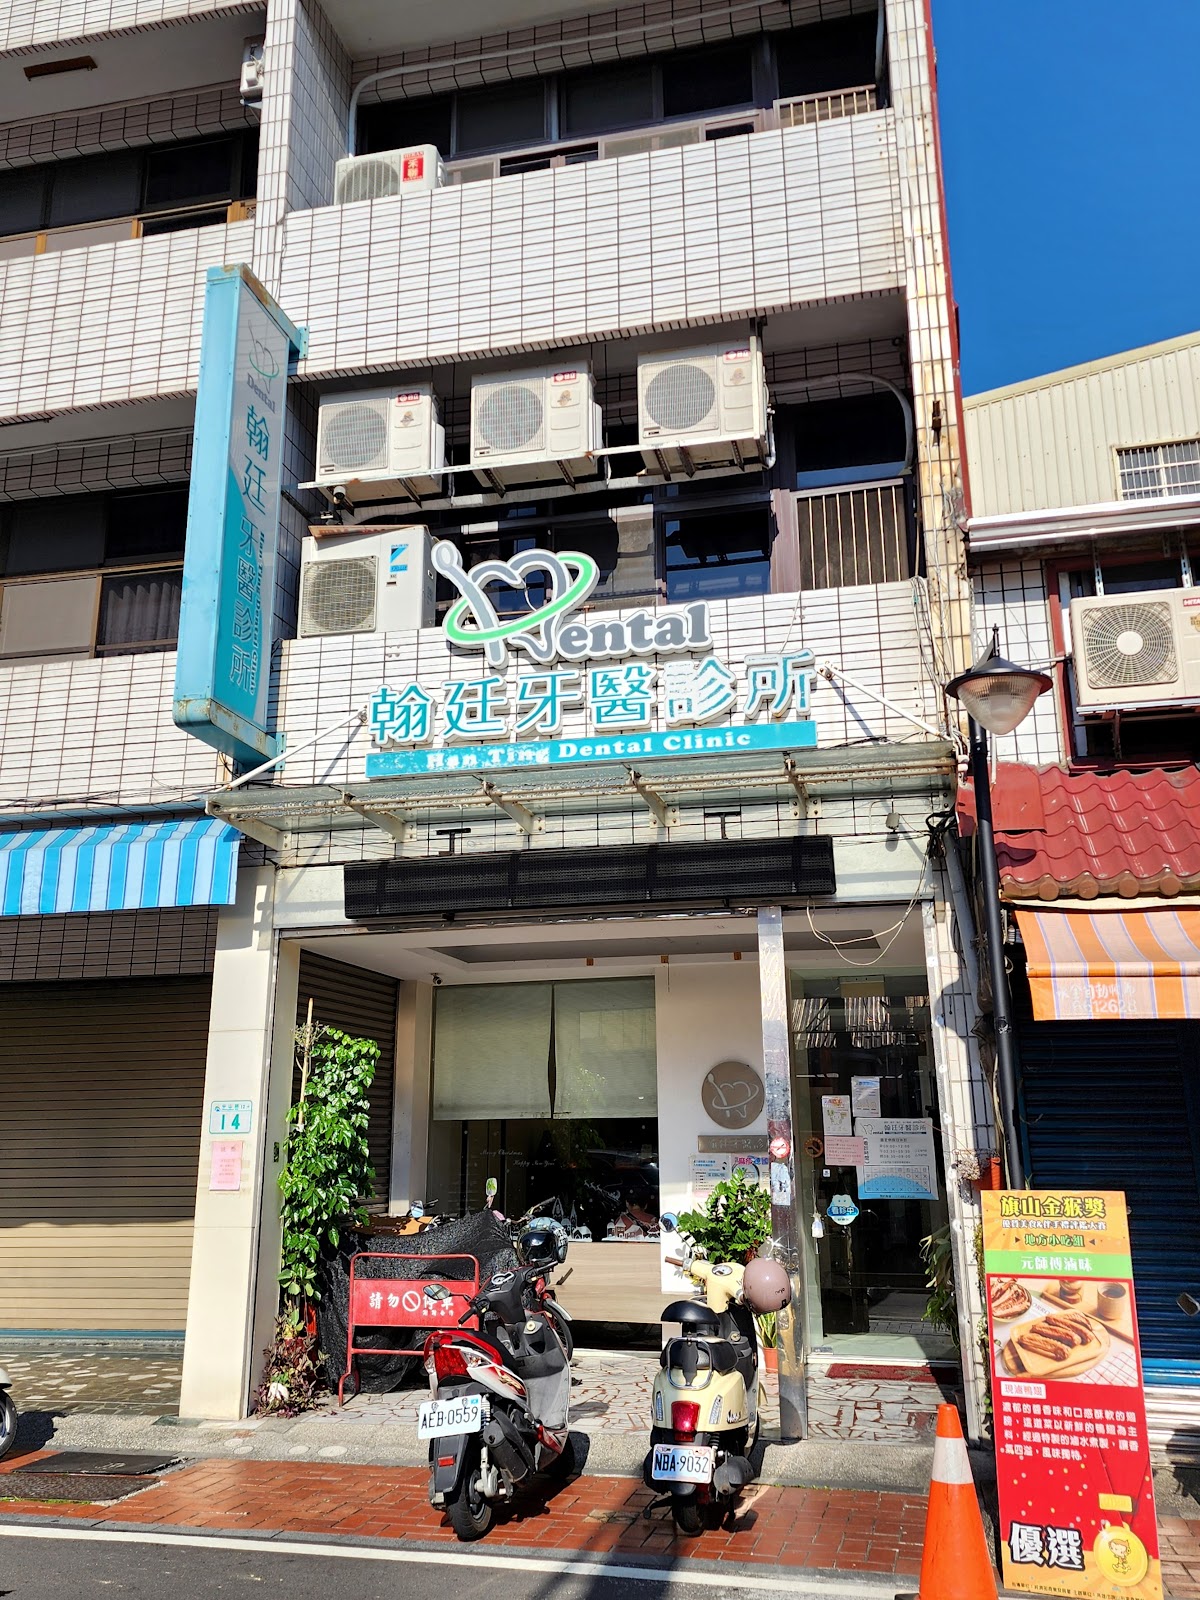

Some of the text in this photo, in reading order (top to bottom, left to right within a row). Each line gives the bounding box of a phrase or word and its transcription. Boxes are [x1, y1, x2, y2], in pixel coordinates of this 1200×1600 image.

[247, 373, 276, 414] Dental
[230, 405, 270, 692] 翰廷牙醫診所
[369, 650, 815, 744] 翰廷牙醫診所
[558, 738, 653, 759] Dental
[663, 729, 751, 749] Clinic
[221, 1114, 240, 1130] 14
[1000, 1196, 1106, 1218] 旗山金猴獎
[1024, 1233, 1085, 1247] 地方小吃組
[1021, 1256, 1092, 1272] 元師傅滷味
[369, 1291, 399, 1309] 請勿
[1010, 1521, 1084, 1570] 優選
